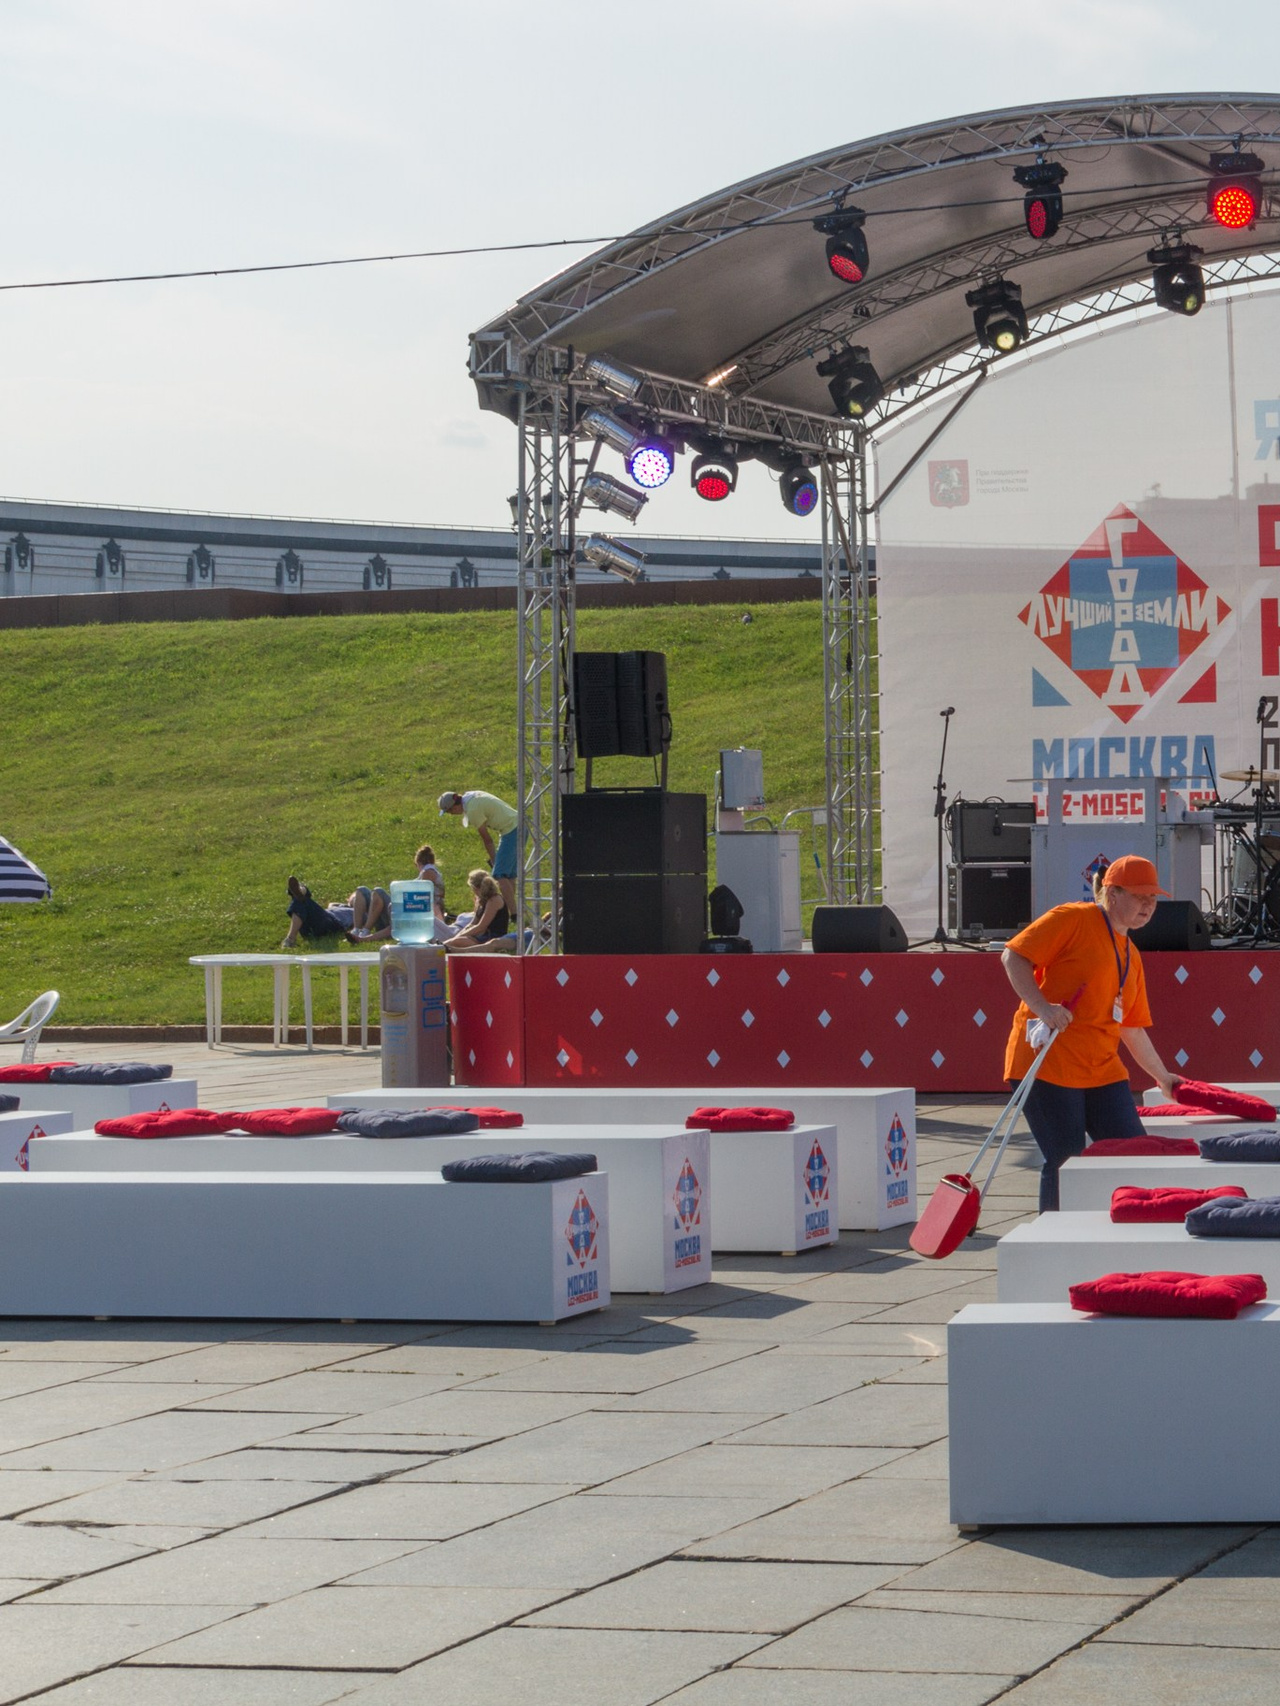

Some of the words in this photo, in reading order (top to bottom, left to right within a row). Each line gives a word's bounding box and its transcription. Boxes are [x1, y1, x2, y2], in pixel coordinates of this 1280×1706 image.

[1027, 592, 1112, 639] ЛУЧШИЙ
[1100, 517, 1150, 706] ГОРОД
[1135, 588, 1218, 634] ЗЕМЛИ
[1032, 734, 1217, 793] МОСКВА
[805, 1208, 830, 1232] МОСКВА
[674, 1234, 701, 1260] МОСКВА
[566, 1269, 599, 1298] МОСКВА
